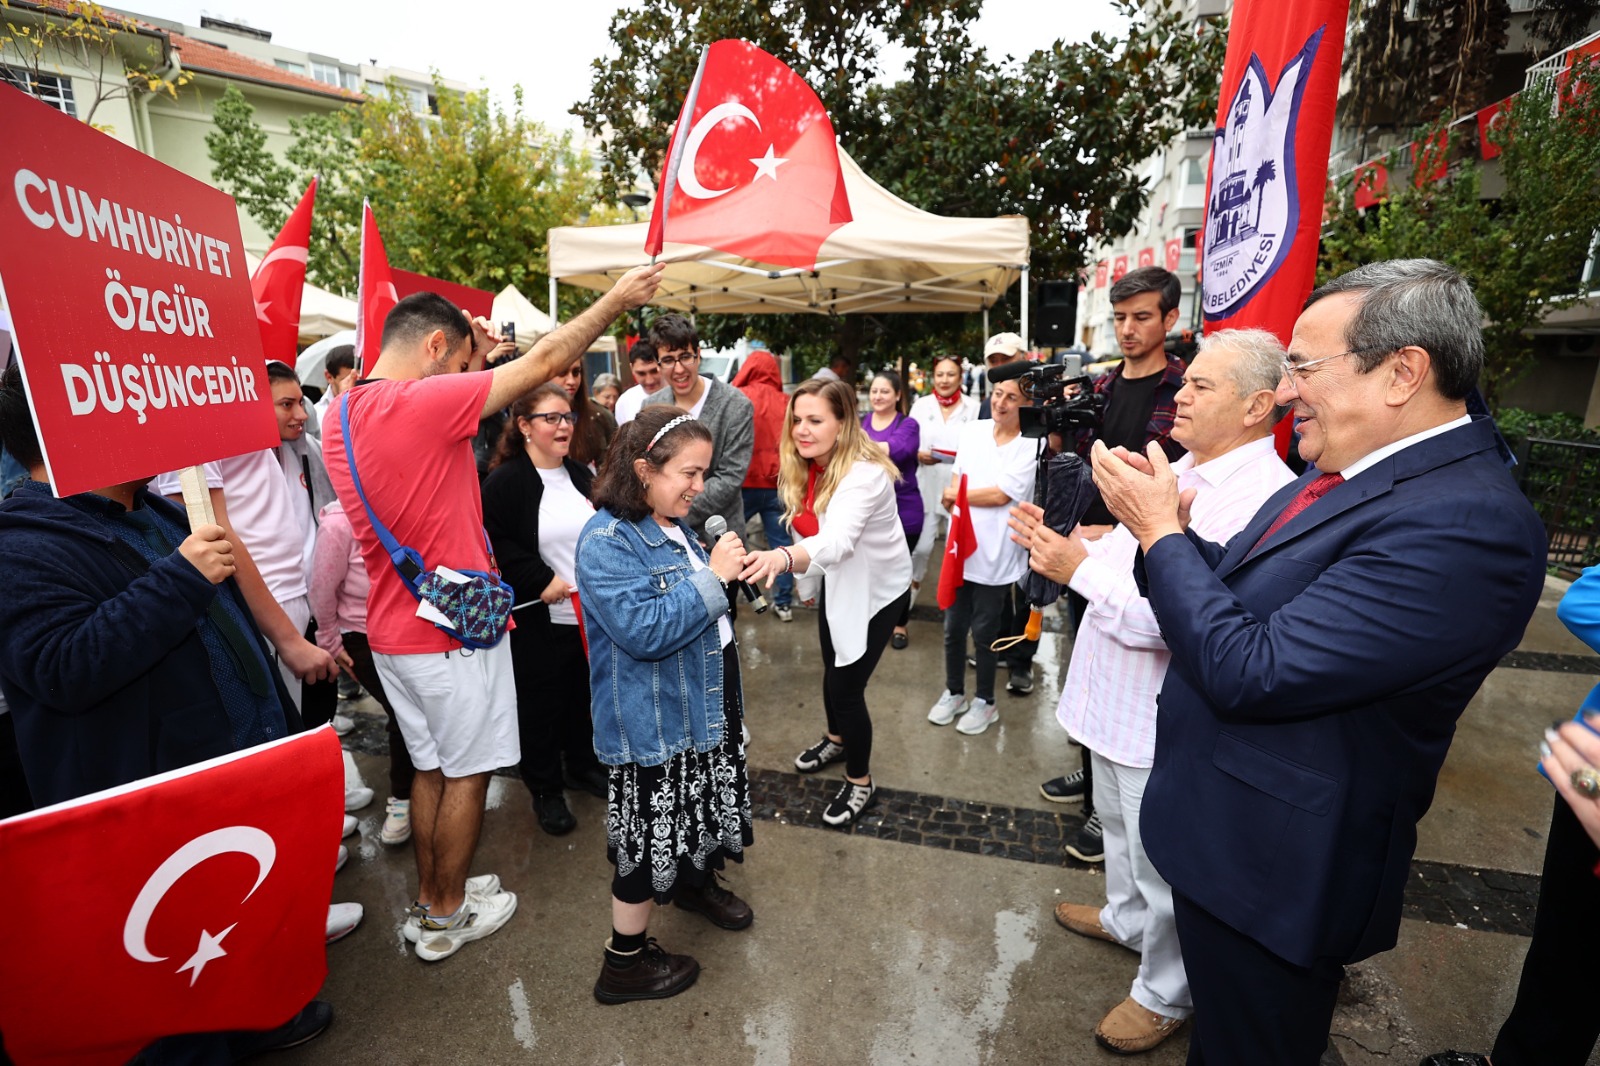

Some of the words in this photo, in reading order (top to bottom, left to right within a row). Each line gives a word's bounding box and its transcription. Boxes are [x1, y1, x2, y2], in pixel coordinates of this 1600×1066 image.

[14, 168, 232, 278] CUMHURİYET
[104, 267, 214, 338] ÖZGÜR
[1210, 233, 1276, 307] BELEDİYESİ
[60, 350, 259, 425] DÜŞÜNCEDİR
